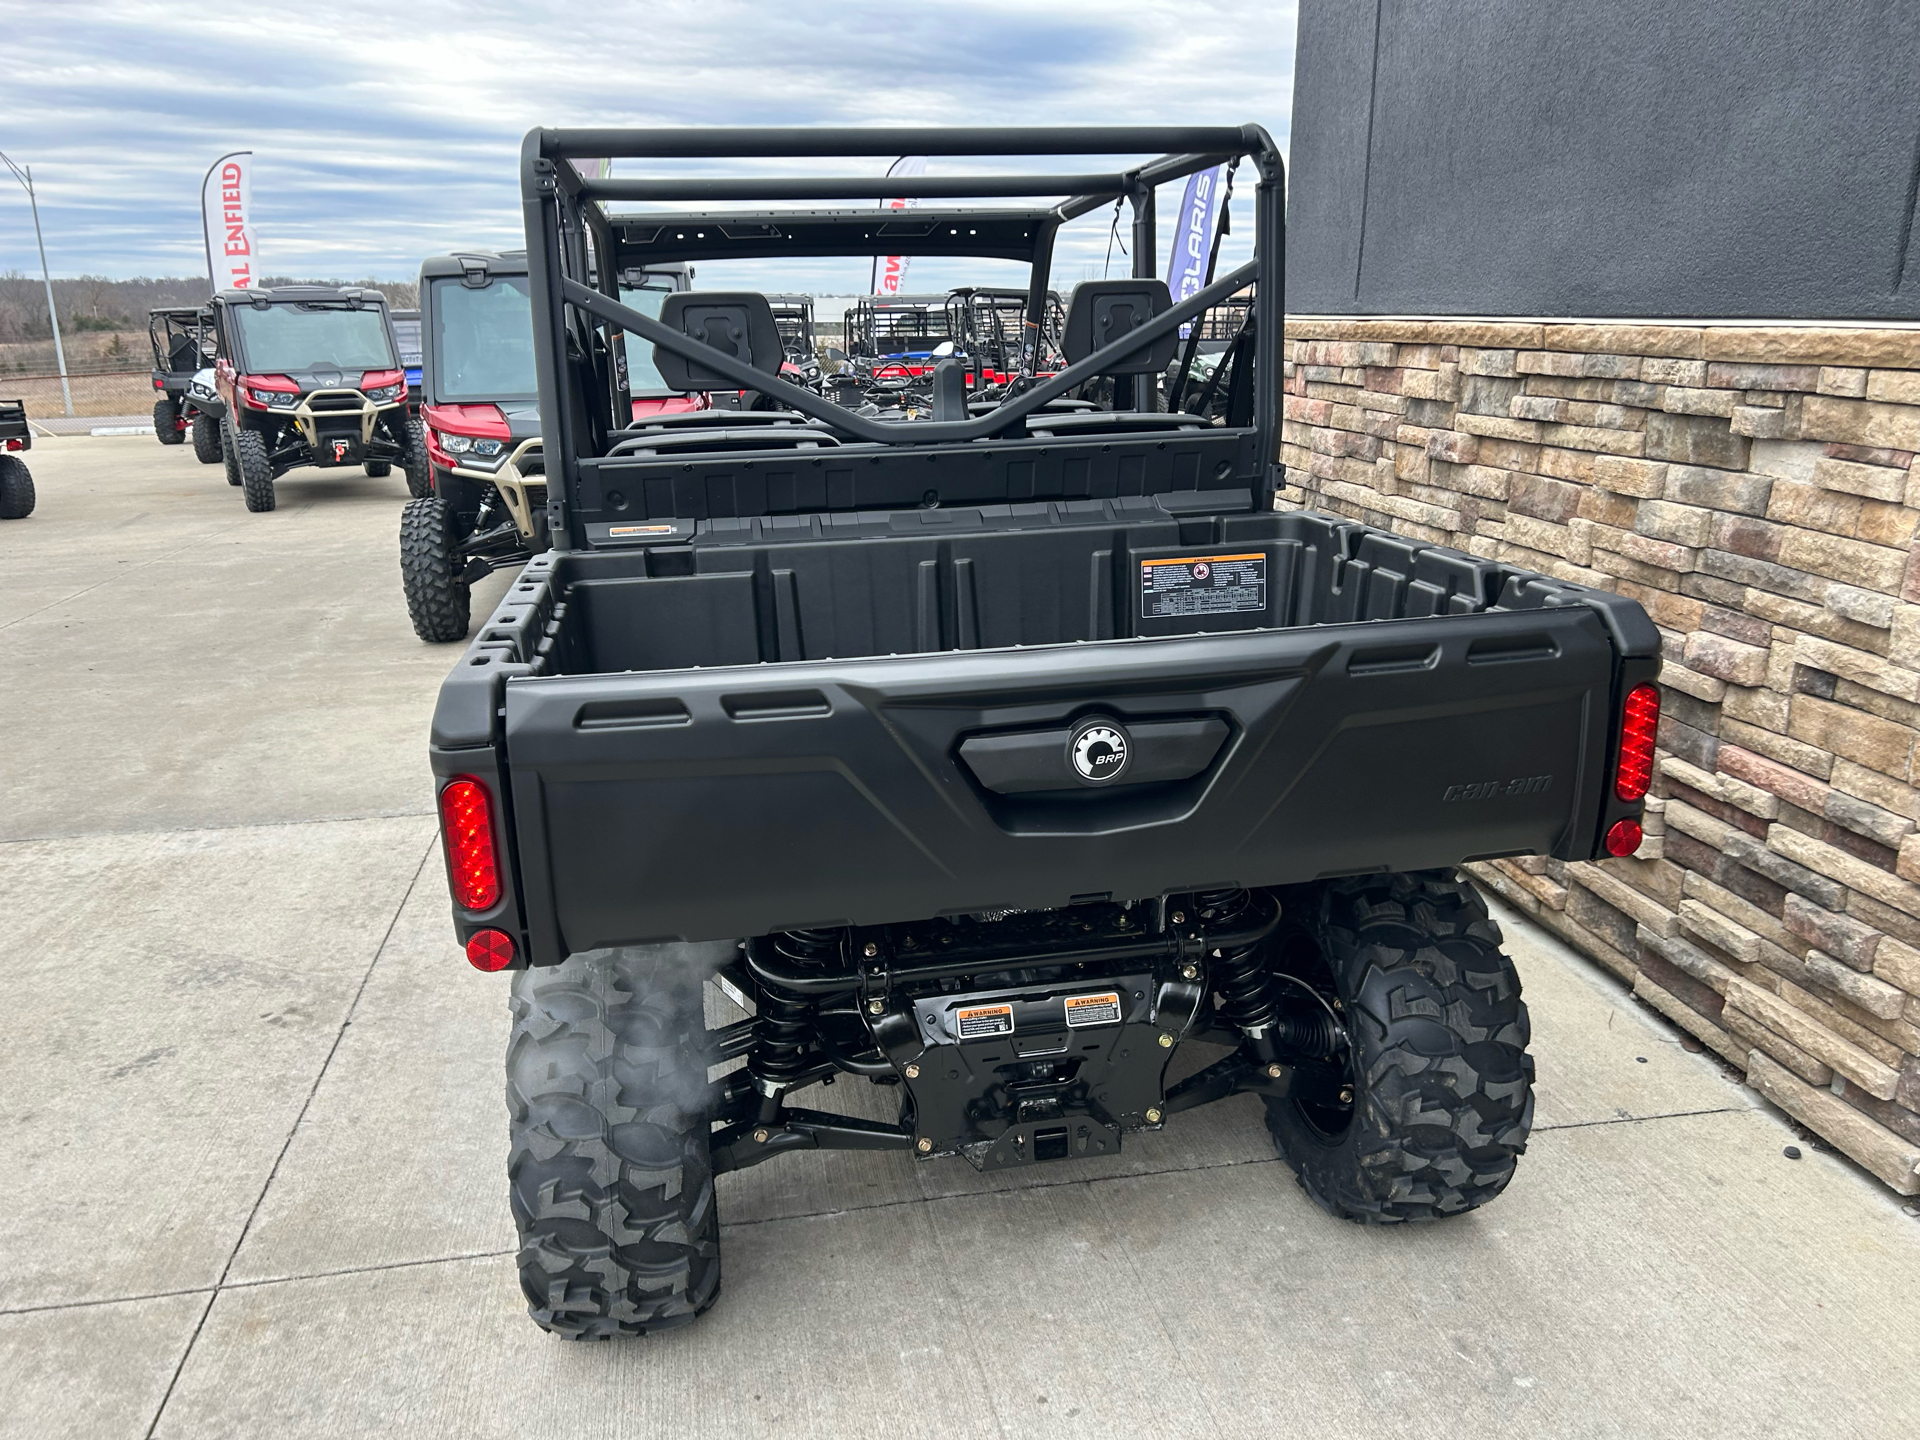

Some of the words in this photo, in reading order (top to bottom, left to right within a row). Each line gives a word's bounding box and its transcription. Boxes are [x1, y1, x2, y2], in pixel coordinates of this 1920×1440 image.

[222, 162, 251, 256] ENFIELD
[1179, 173, 1211, 304] OLARIS
[1095, 752, 1124, 765] BRP
[1442, 774, 1553, 801] can-am
[1080, 997, 1110, 1005] WARNING
[973, 1008, 1003, 1017] WARNING
